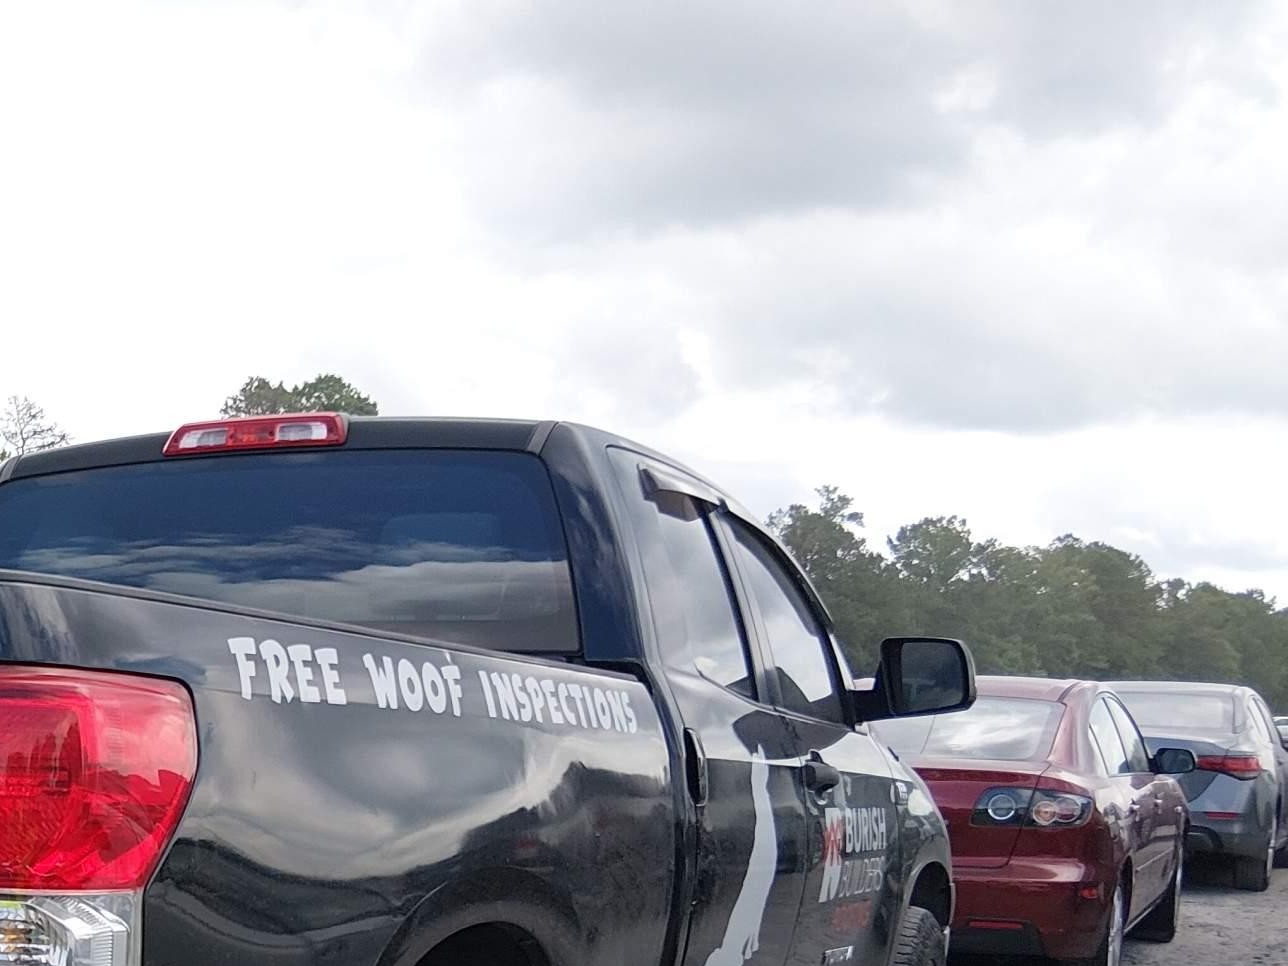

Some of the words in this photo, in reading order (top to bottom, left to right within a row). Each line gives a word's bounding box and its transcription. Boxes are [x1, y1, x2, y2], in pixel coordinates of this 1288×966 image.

[227, 636, 347, 705] FREE
[362, 652, 464, 717] WOOF
[478, 670, 638, 734] INSPECTIONS
[845, 807, 887, 853] BURISH
